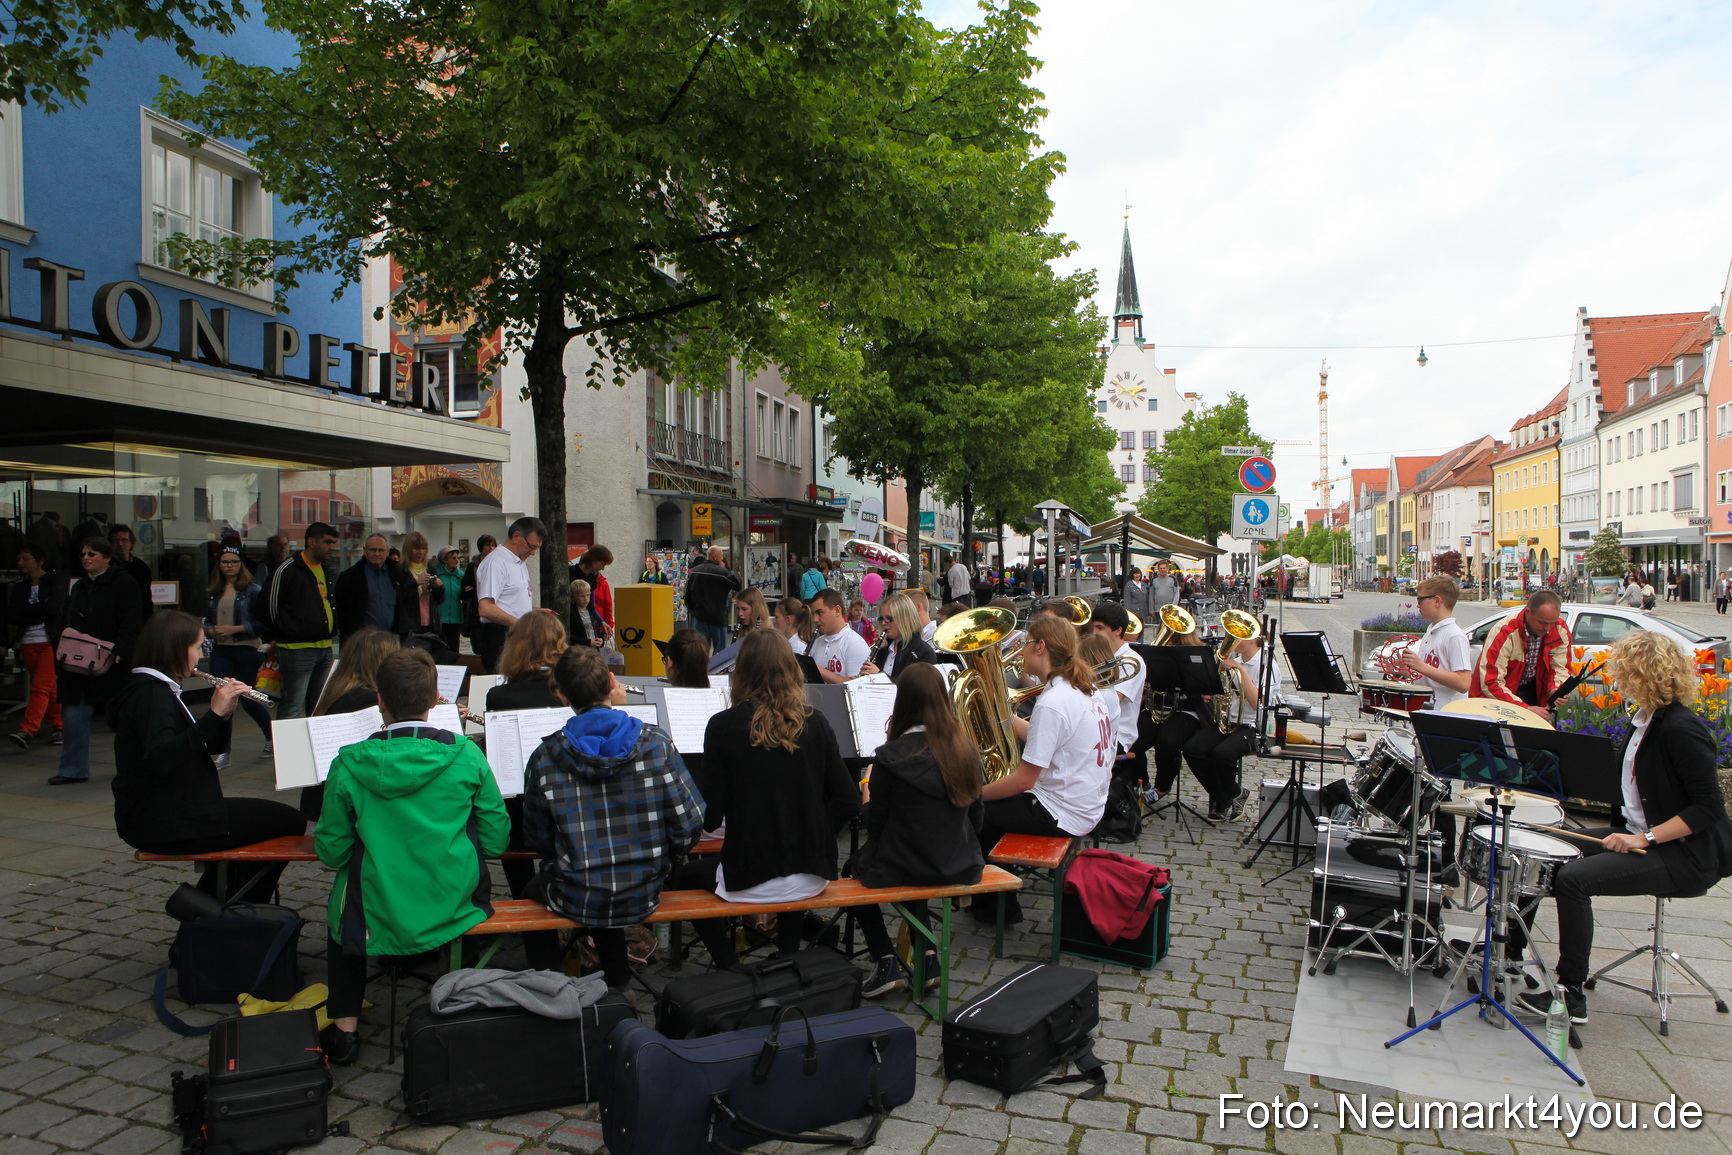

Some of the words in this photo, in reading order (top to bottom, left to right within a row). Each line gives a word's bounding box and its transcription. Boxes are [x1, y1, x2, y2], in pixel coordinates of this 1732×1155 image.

[0, 247, 230, 365] TON
[263, 321, 451, 418] PETER
[862, 512, 878, 523] BASE
[855, 543, 900, 567] RENO
